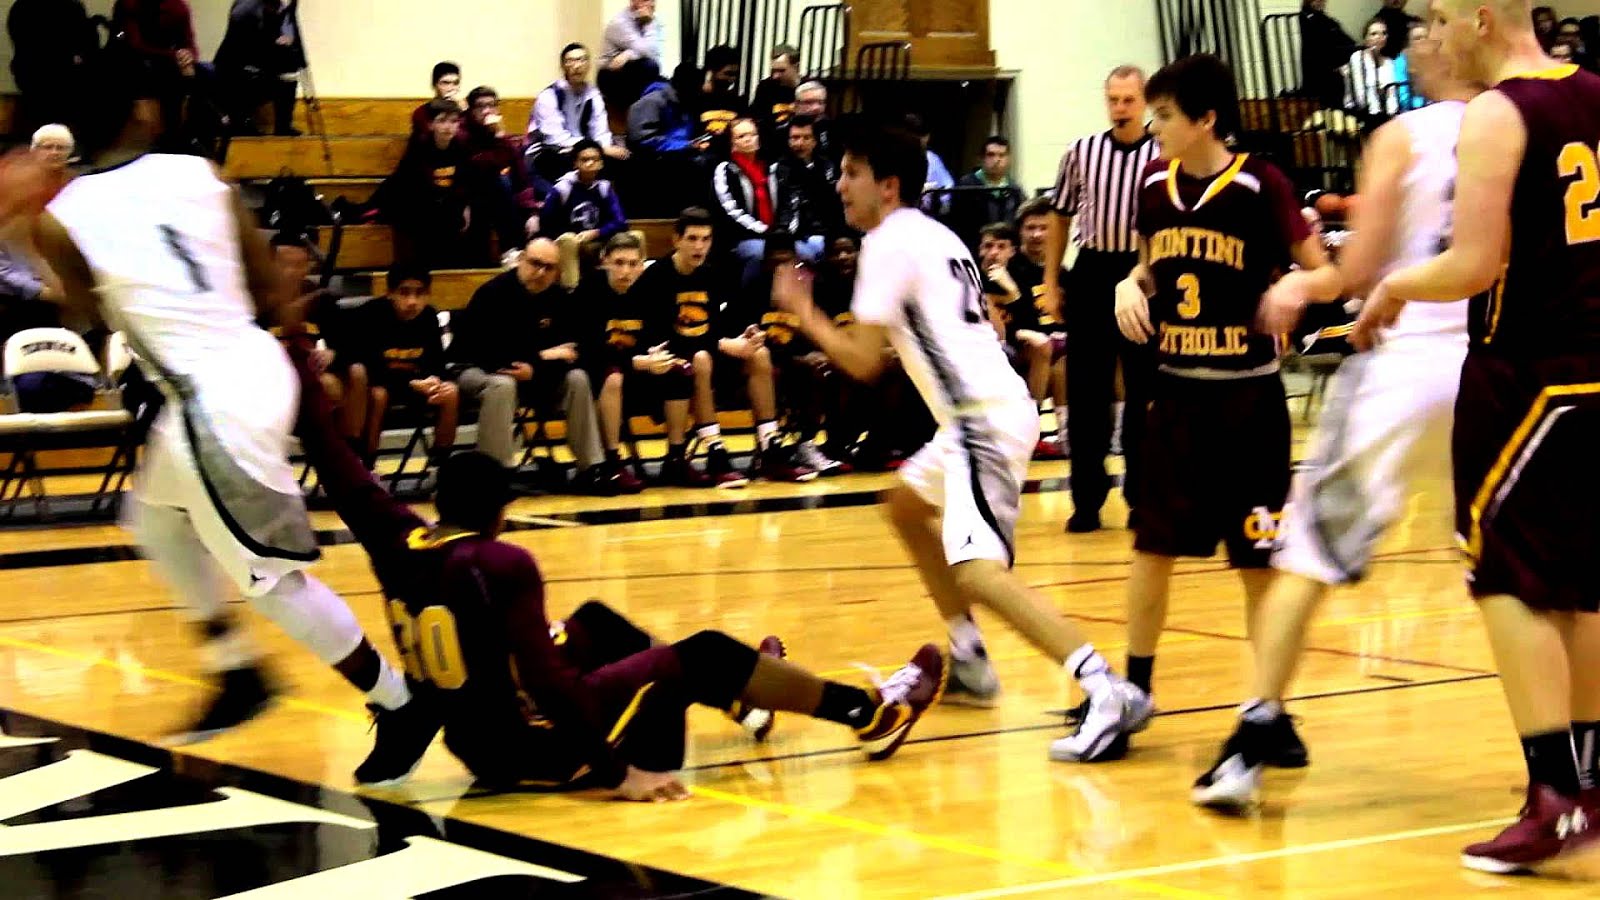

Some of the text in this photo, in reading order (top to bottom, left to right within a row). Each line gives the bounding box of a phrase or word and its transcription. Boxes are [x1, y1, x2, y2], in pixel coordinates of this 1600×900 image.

[1557, 139, 1600, 246] 2
[1176, 272, 1201, 319] 3
[1160, 322, 1248, 356] THOLIC
